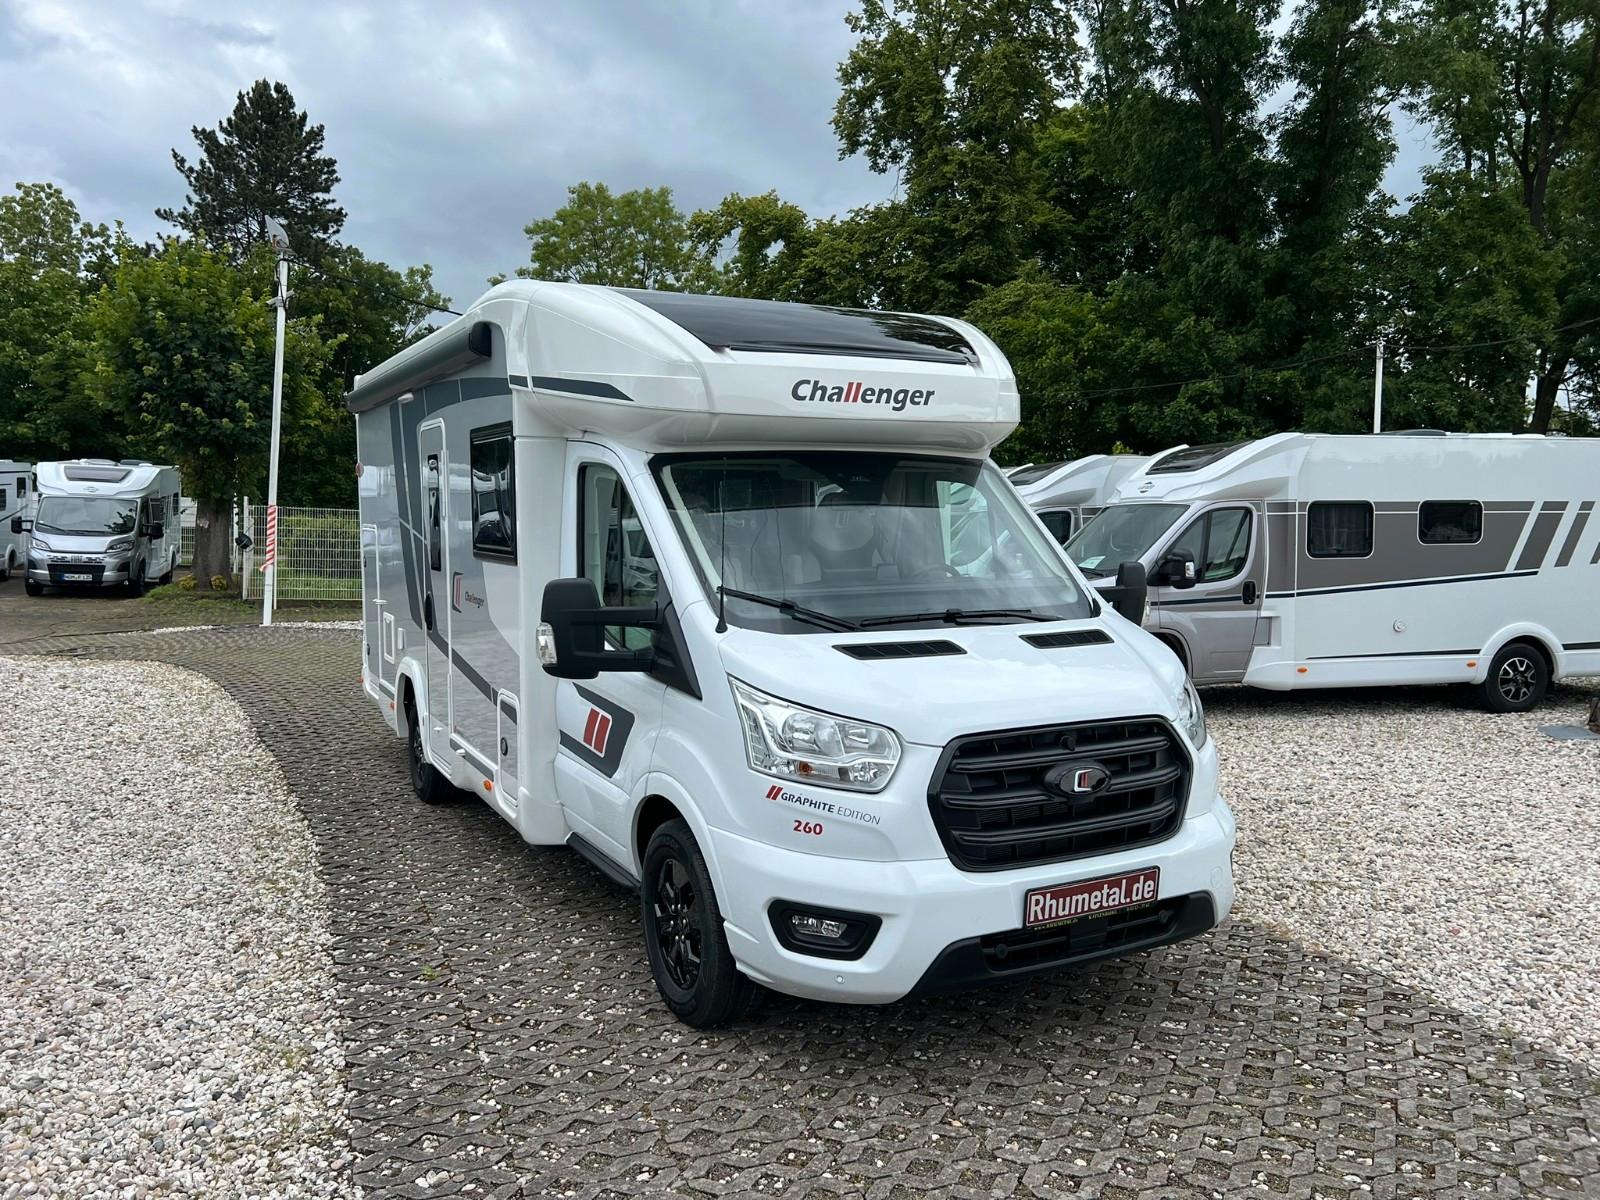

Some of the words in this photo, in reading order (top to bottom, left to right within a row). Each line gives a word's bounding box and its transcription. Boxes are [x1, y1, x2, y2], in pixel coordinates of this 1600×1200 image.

[791, 379, 935, 411] Challenger
[464, 591, 485, 608] Challenger
[780, 791, 836, 813] GRAPHITE
[837, 806, 881, 825] EDITION
[793, 819, 823, 835] 260
[1029, 876, 1155, 922] Rhumetal.de
